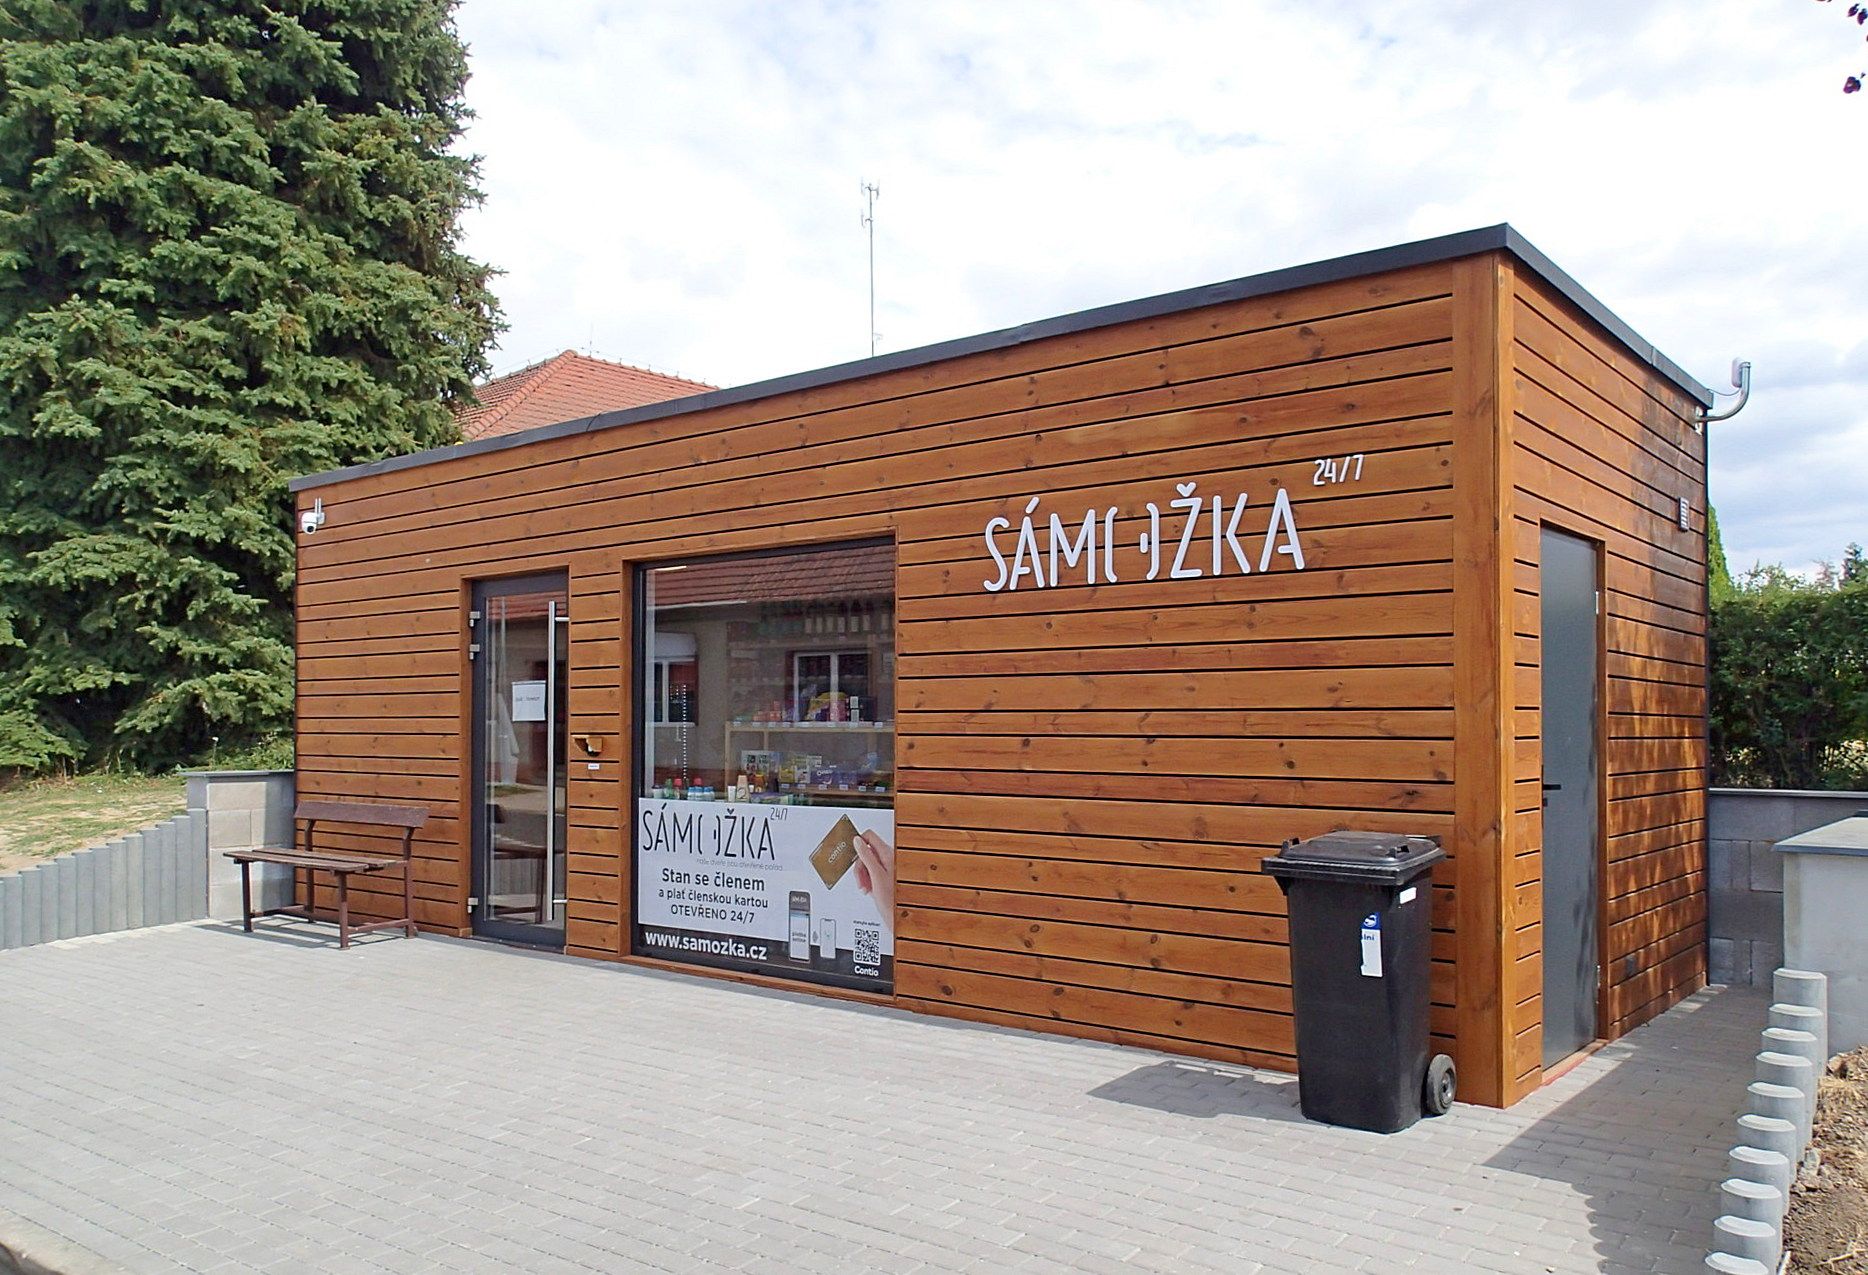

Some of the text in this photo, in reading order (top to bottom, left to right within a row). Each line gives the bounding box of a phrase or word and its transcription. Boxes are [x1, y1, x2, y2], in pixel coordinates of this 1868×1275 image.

[1313, 453, 1364, 486] 24/7
[770, 807, 788, 821] 24/7
[662, 867, 765, 891] Stan se členem
[658, 888, 768, 908] a plať členskou kartou
[670, 904, 755, 924] OTEVŘENO 24/7
[645, 931, 767, 960] www.samozka.cz
[854, 966, 879, 977] Contio
